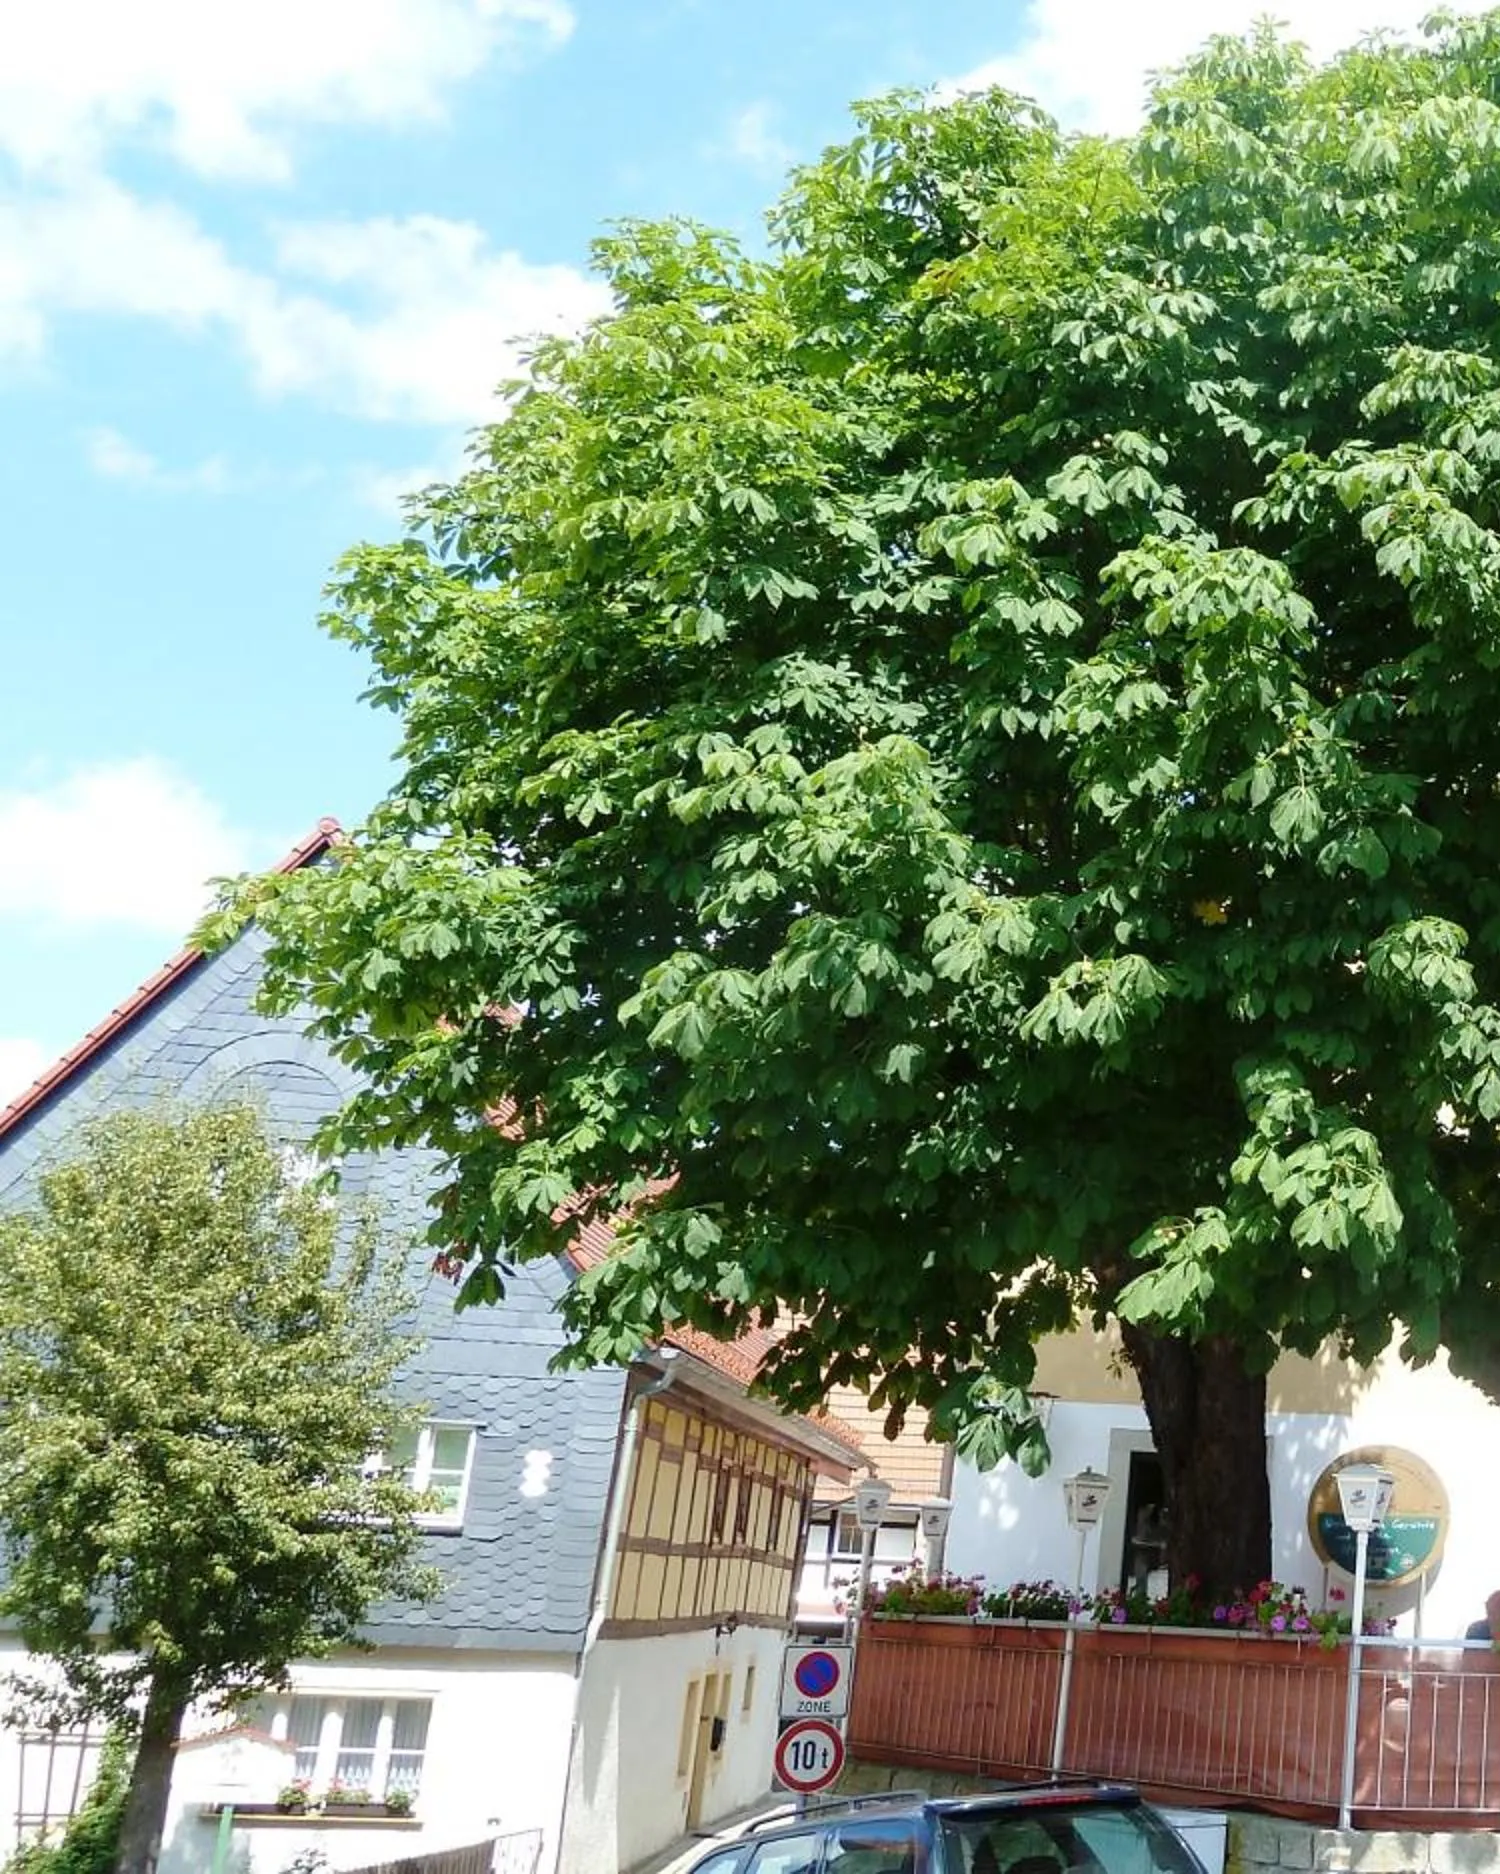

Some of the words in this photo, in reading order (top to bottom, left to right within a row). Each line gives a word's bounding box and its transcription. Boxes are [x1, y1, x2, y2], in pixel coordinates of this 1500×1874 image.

[797, 1700, 831, 1713] ZONE
[791, 1740, 817, 1771] 10
[821, 1748, 829, 1769] t
